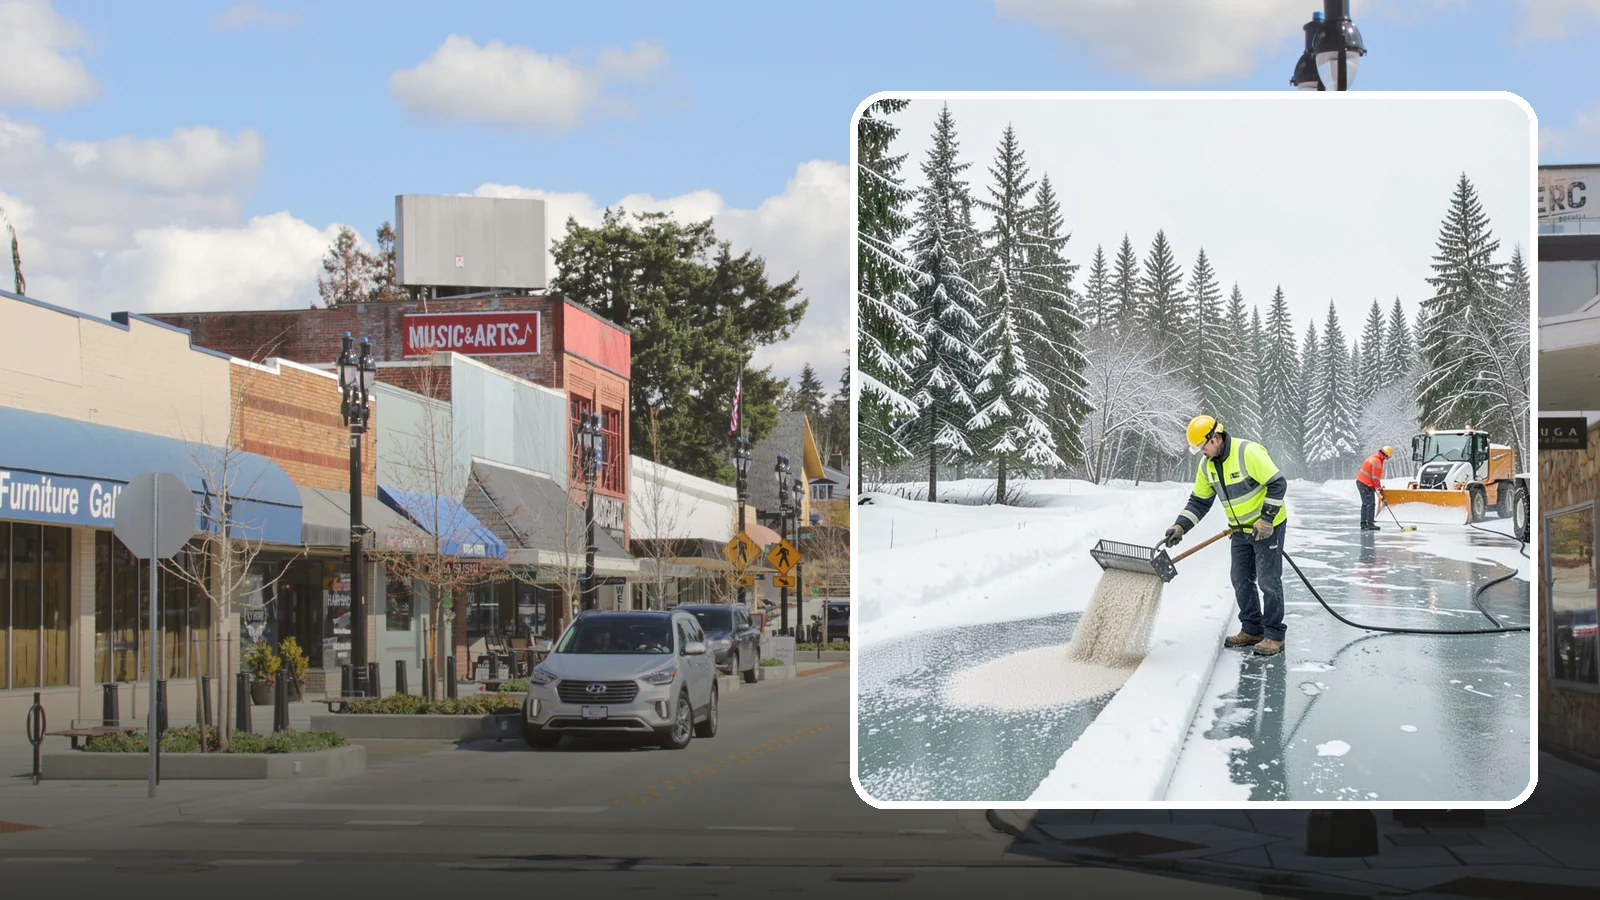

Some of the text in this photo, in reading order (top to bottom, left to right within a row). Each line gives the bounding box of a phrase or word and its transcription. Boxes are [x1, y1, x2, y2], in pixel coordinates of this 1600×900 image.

[409, 323, 519, 348] MUSIC&ARTS
[0, 471, 121, 519] Furniture Gal
